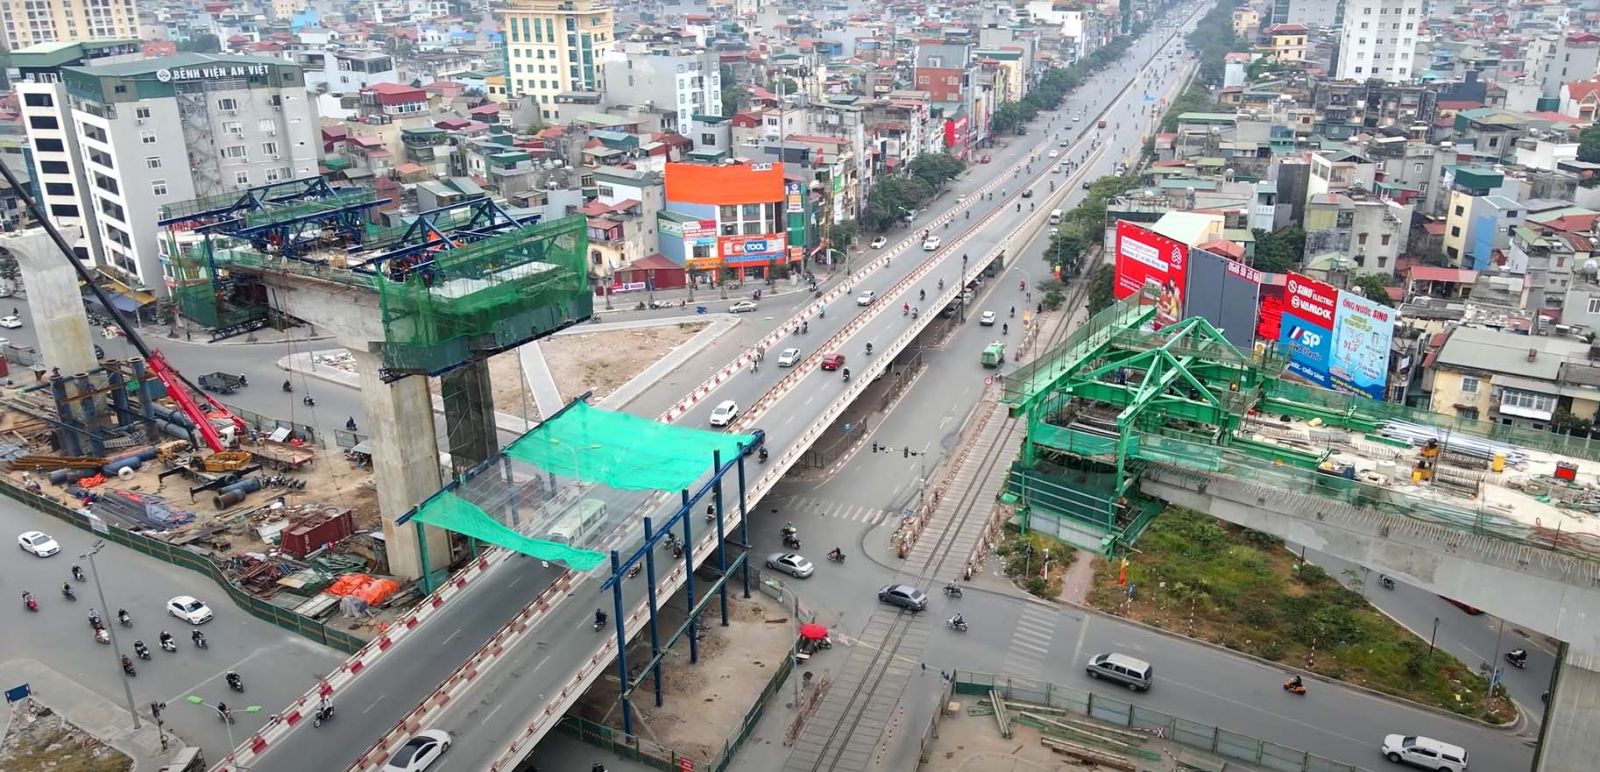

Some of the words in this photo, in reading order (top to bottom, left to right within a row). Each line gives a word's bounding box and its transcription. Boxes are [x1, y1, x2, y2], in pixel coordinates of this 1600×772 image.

[203, 66, 226, 79] VIỆN
[231, 66, 245, 76] AN
[248, 62, 269, 77] VIỆT
[747, 243, 765, 251] TOOL
[1297, 284, 1313, 298] SINO
[1312, 293, 1334, 307] ELECTRIC
[1373, 310, 1388, 322] SINO
[1302, 330, 1321, 347] SP
